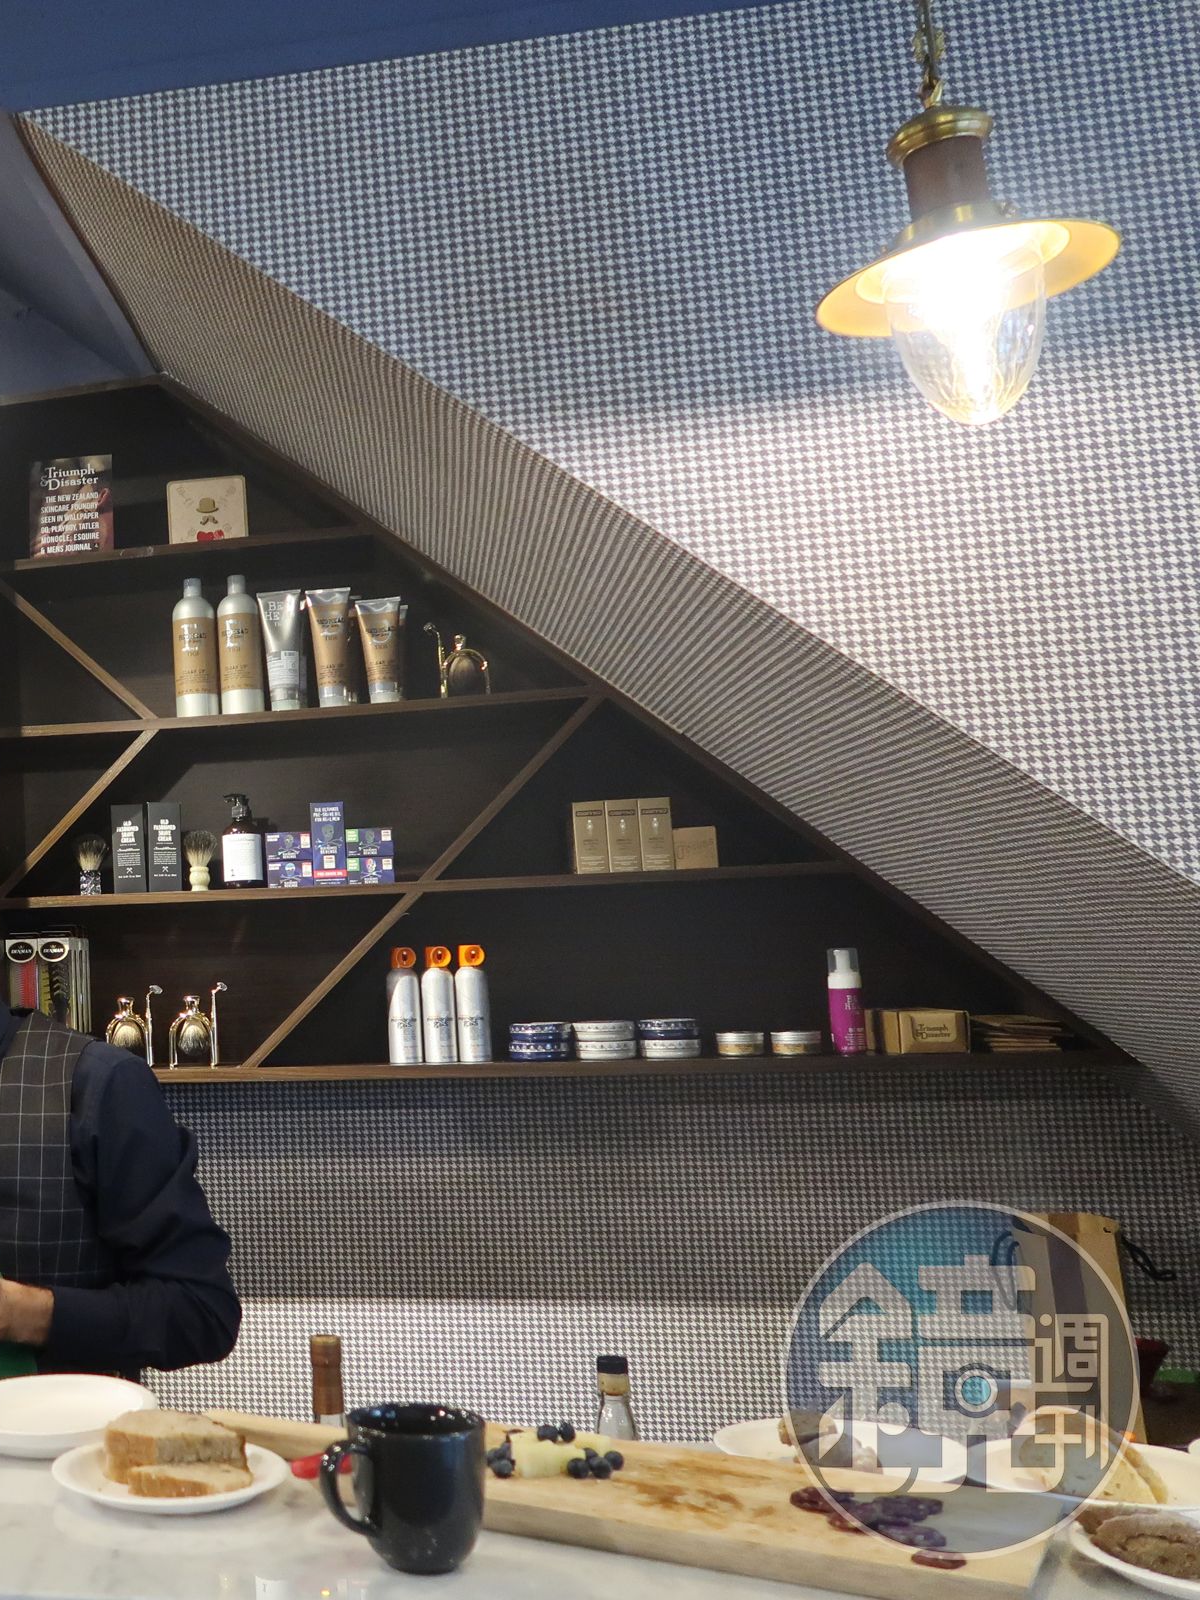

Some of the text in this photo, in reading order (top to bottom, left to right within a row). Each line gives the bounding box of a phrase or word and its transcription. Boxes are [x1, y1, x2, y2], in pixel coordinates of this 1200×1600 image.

[45, 463, 95, 478] Triumph
[48, 477, 99, 491] Disaster
[57, 494, 71, 502] NEW
[72, 492, 99, 501] ZEALAND
[41, 504, 70, 514] SKINCARE
[41, 512, 99, 524] SEEN IN WALLPAPER
[74, 532, 100, 541] ESQUIRE
[65, 543, 92, 552] JOURNAL
